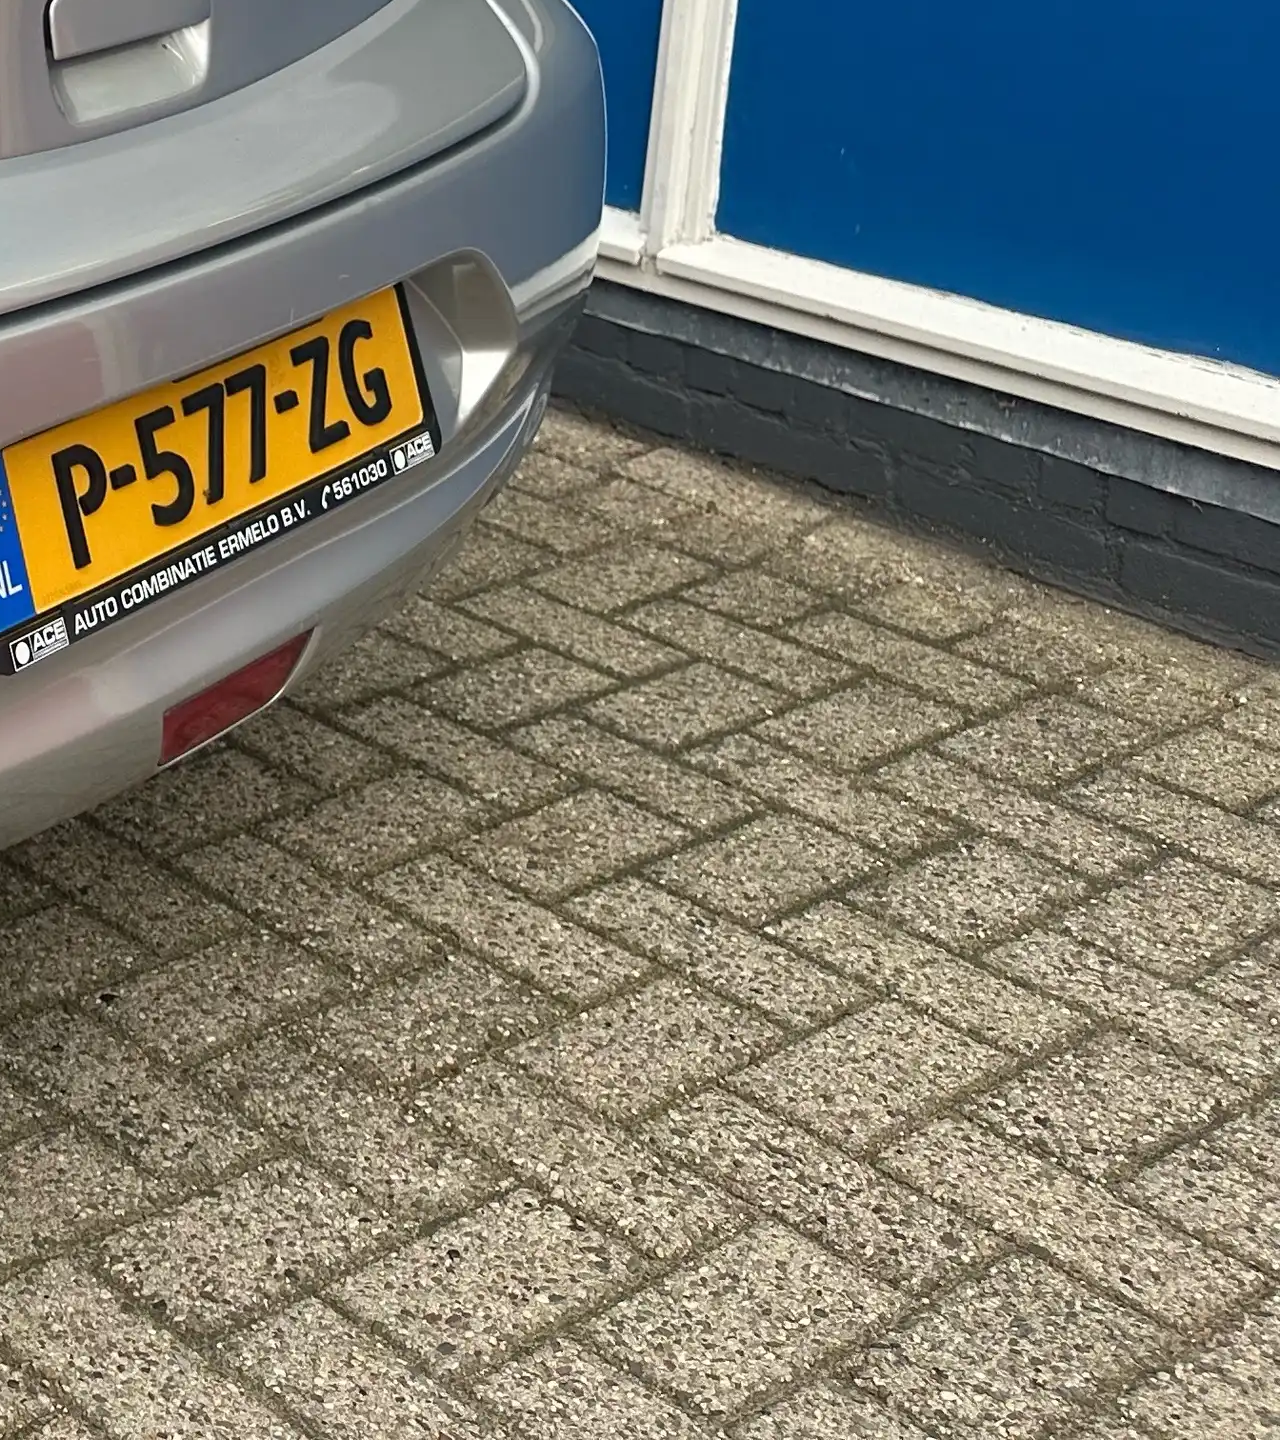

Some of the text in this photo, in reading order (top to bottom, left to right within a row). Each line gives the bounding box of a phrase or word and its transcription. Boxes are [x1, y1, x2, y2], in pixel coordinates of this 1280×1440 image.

[33, 621, 65, 652] ACE
[74, 596, 118, 635] AUTO
[120, 545, 218, 610] COMBINATIE
[218, 514, 280, 560] ERMELO
[280, 499, 311, 528] B.V.
[332, 459, 388, 500] 561030
[406, 434, 432, 459] ACE
[51, 319, 393, 570] P-577-ZG
